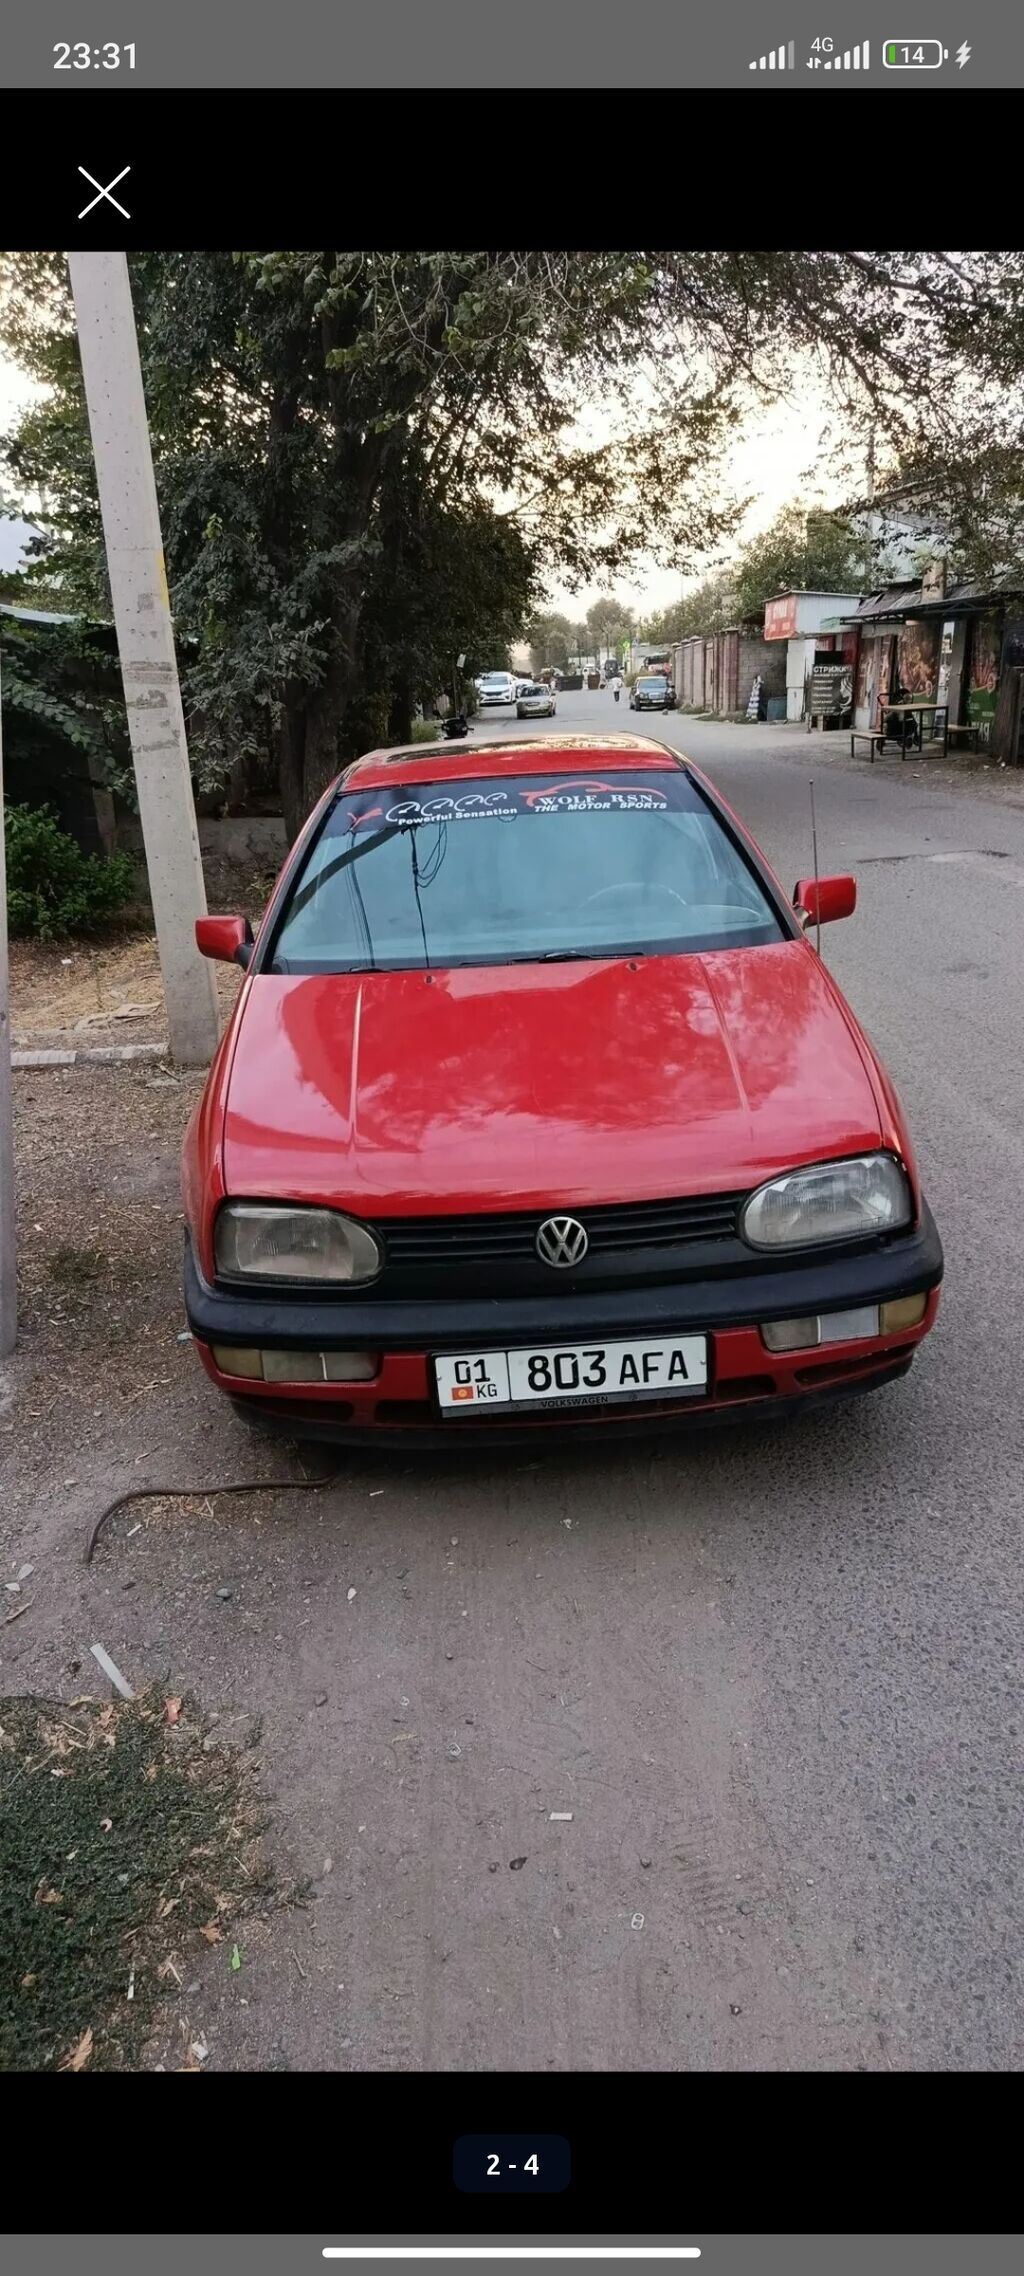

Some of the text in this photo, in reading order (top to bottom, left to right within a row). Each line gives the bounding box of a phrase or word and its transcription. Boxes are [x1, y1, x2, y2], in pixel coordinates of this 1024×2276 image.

[534, 801, 667, 812] THE MOTOR SPORTS
[538, 794, 653, 806] WOLF RSN
[398, 807, 518, 825] Powerful Sensation
[454, 1350, 689, 1392] 01 803 AFA
[476, 1383, 498, 1399] KG
[541, 1396, 609, 1408] VOLKSWAGEN
